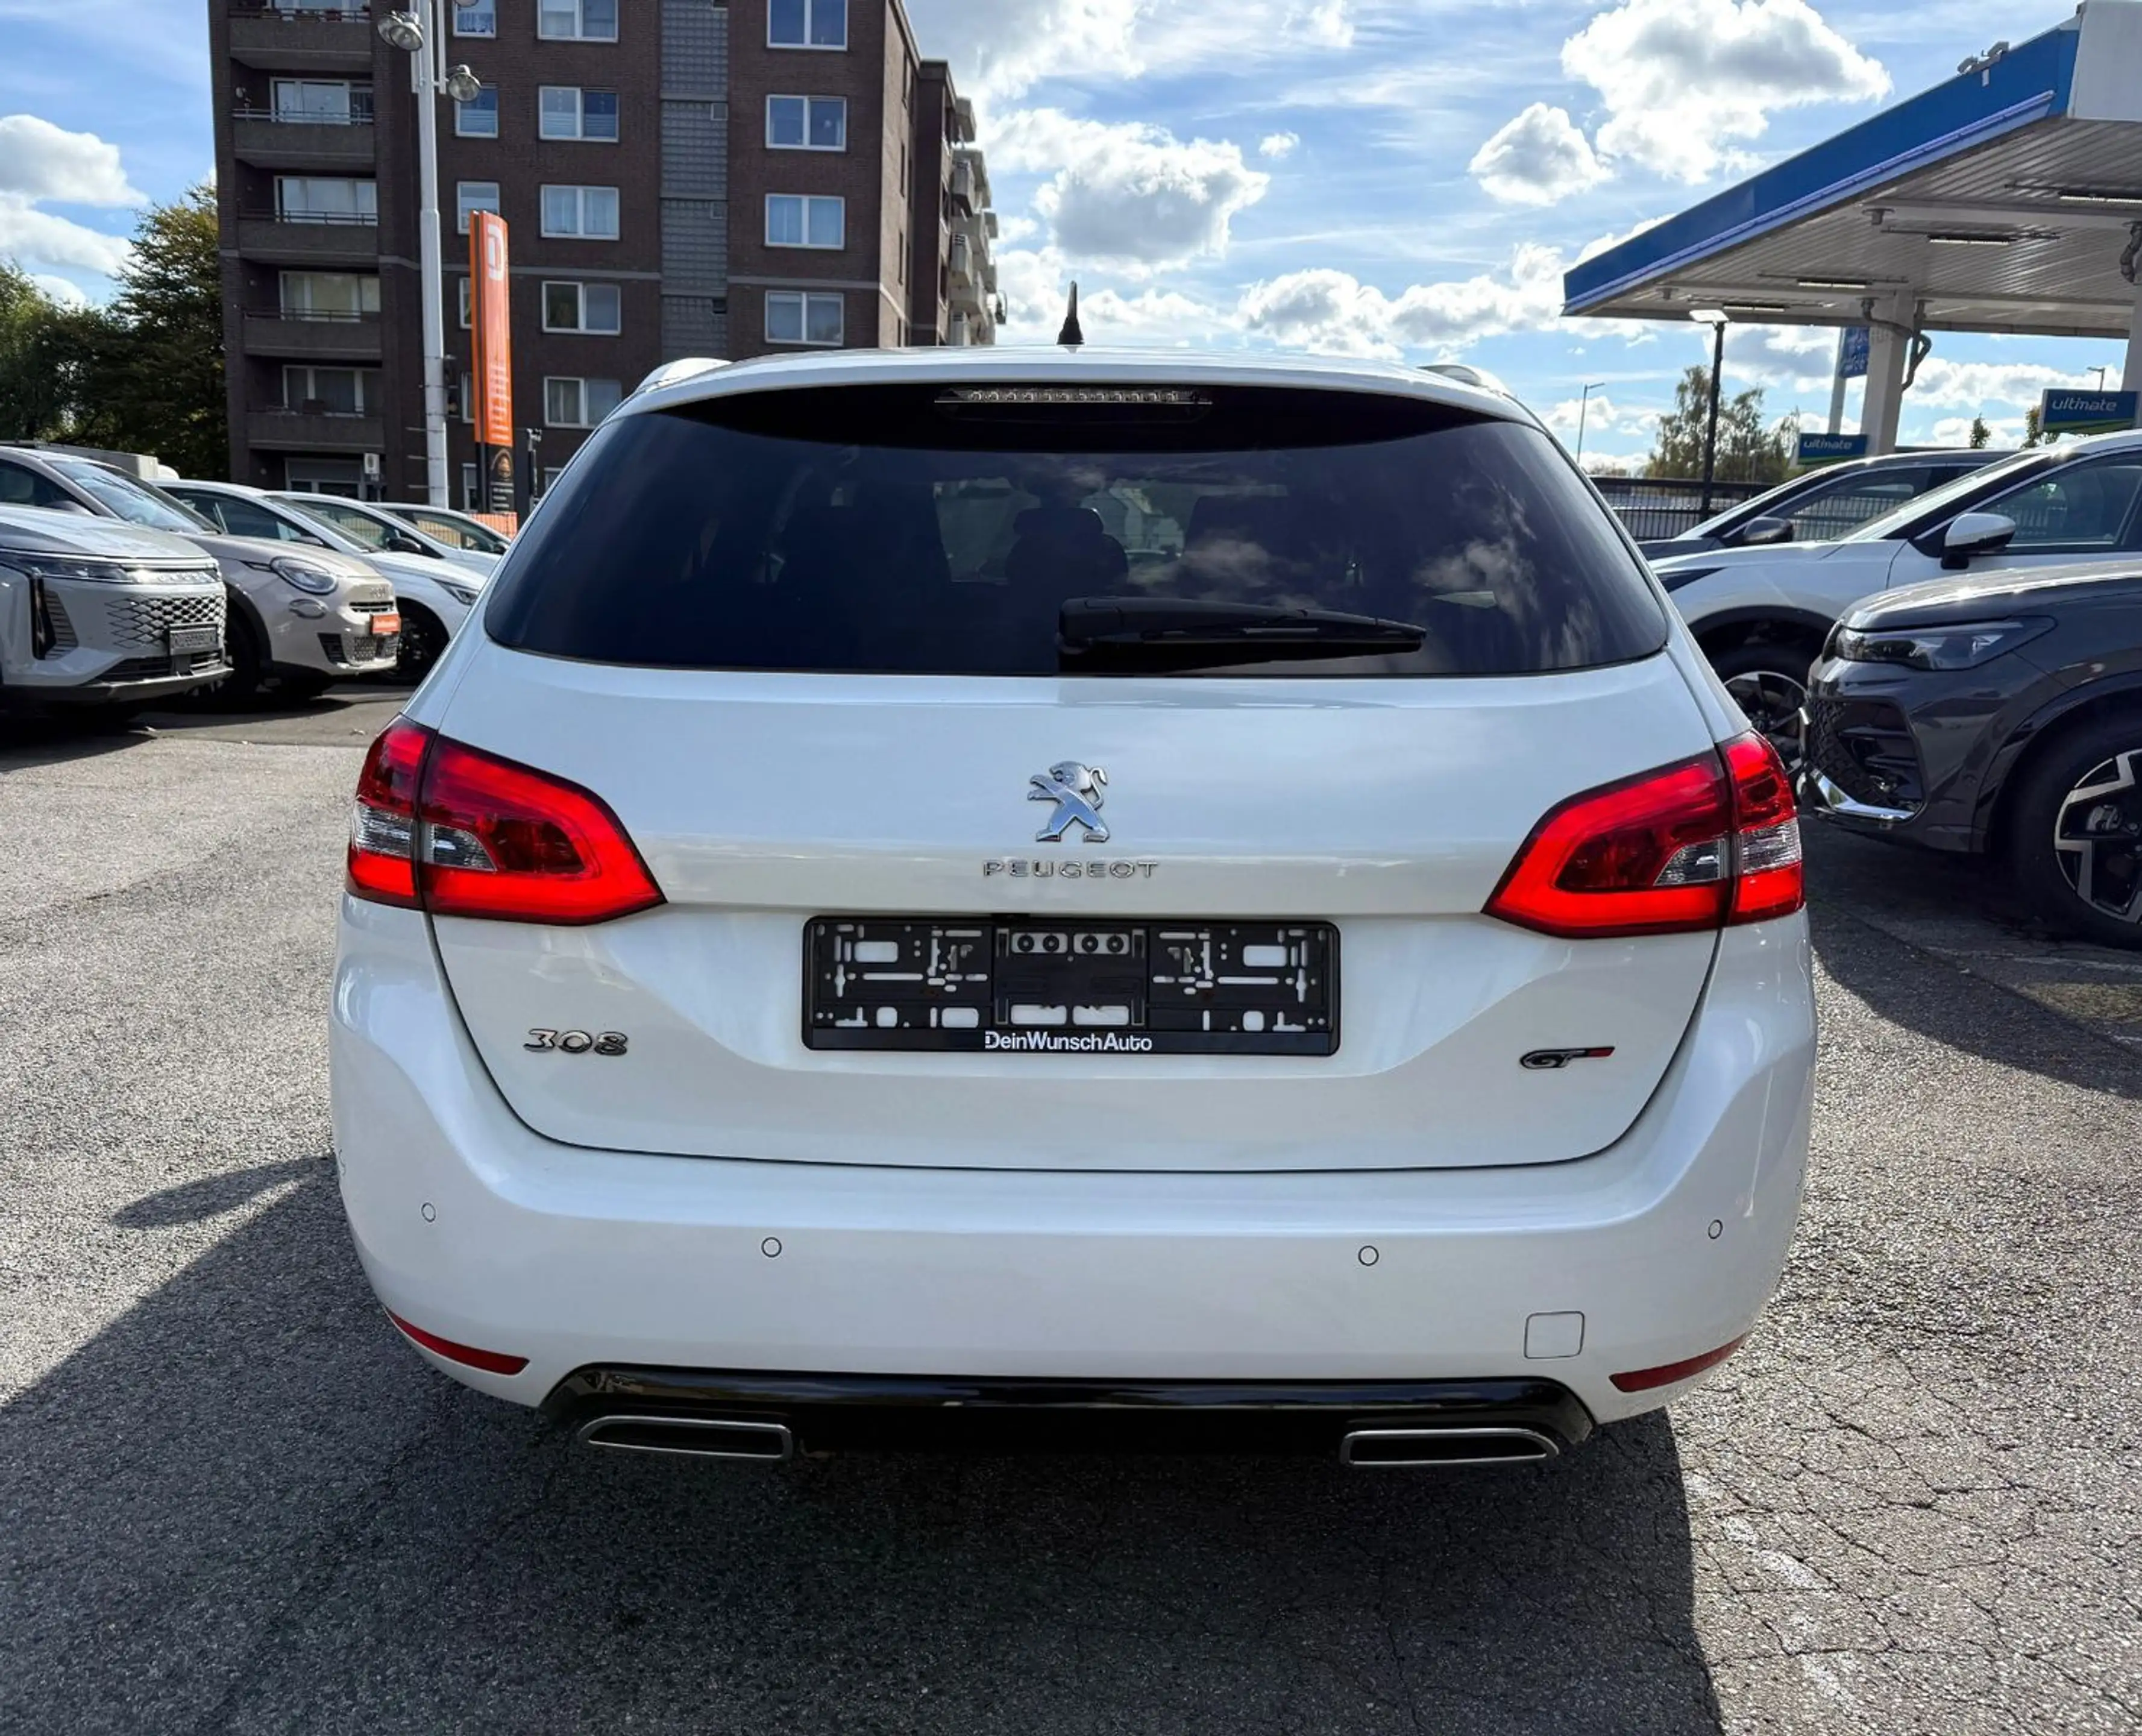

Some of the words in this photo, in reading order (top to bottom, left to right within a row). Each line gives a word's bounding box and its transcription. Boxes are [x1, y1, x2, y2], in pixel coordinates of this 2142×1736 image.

[2052, 397, 2117, 412] ultimate
[1804, 438, 1852, 450] ultimate
[984, 859, 1158, 878] PEUGEOT
[523, 1028, 628, 1055] 308
[985, 1031, 1152, 1051] DeinWunschAuto
[1519, 1046, 1615, 1069] GT
